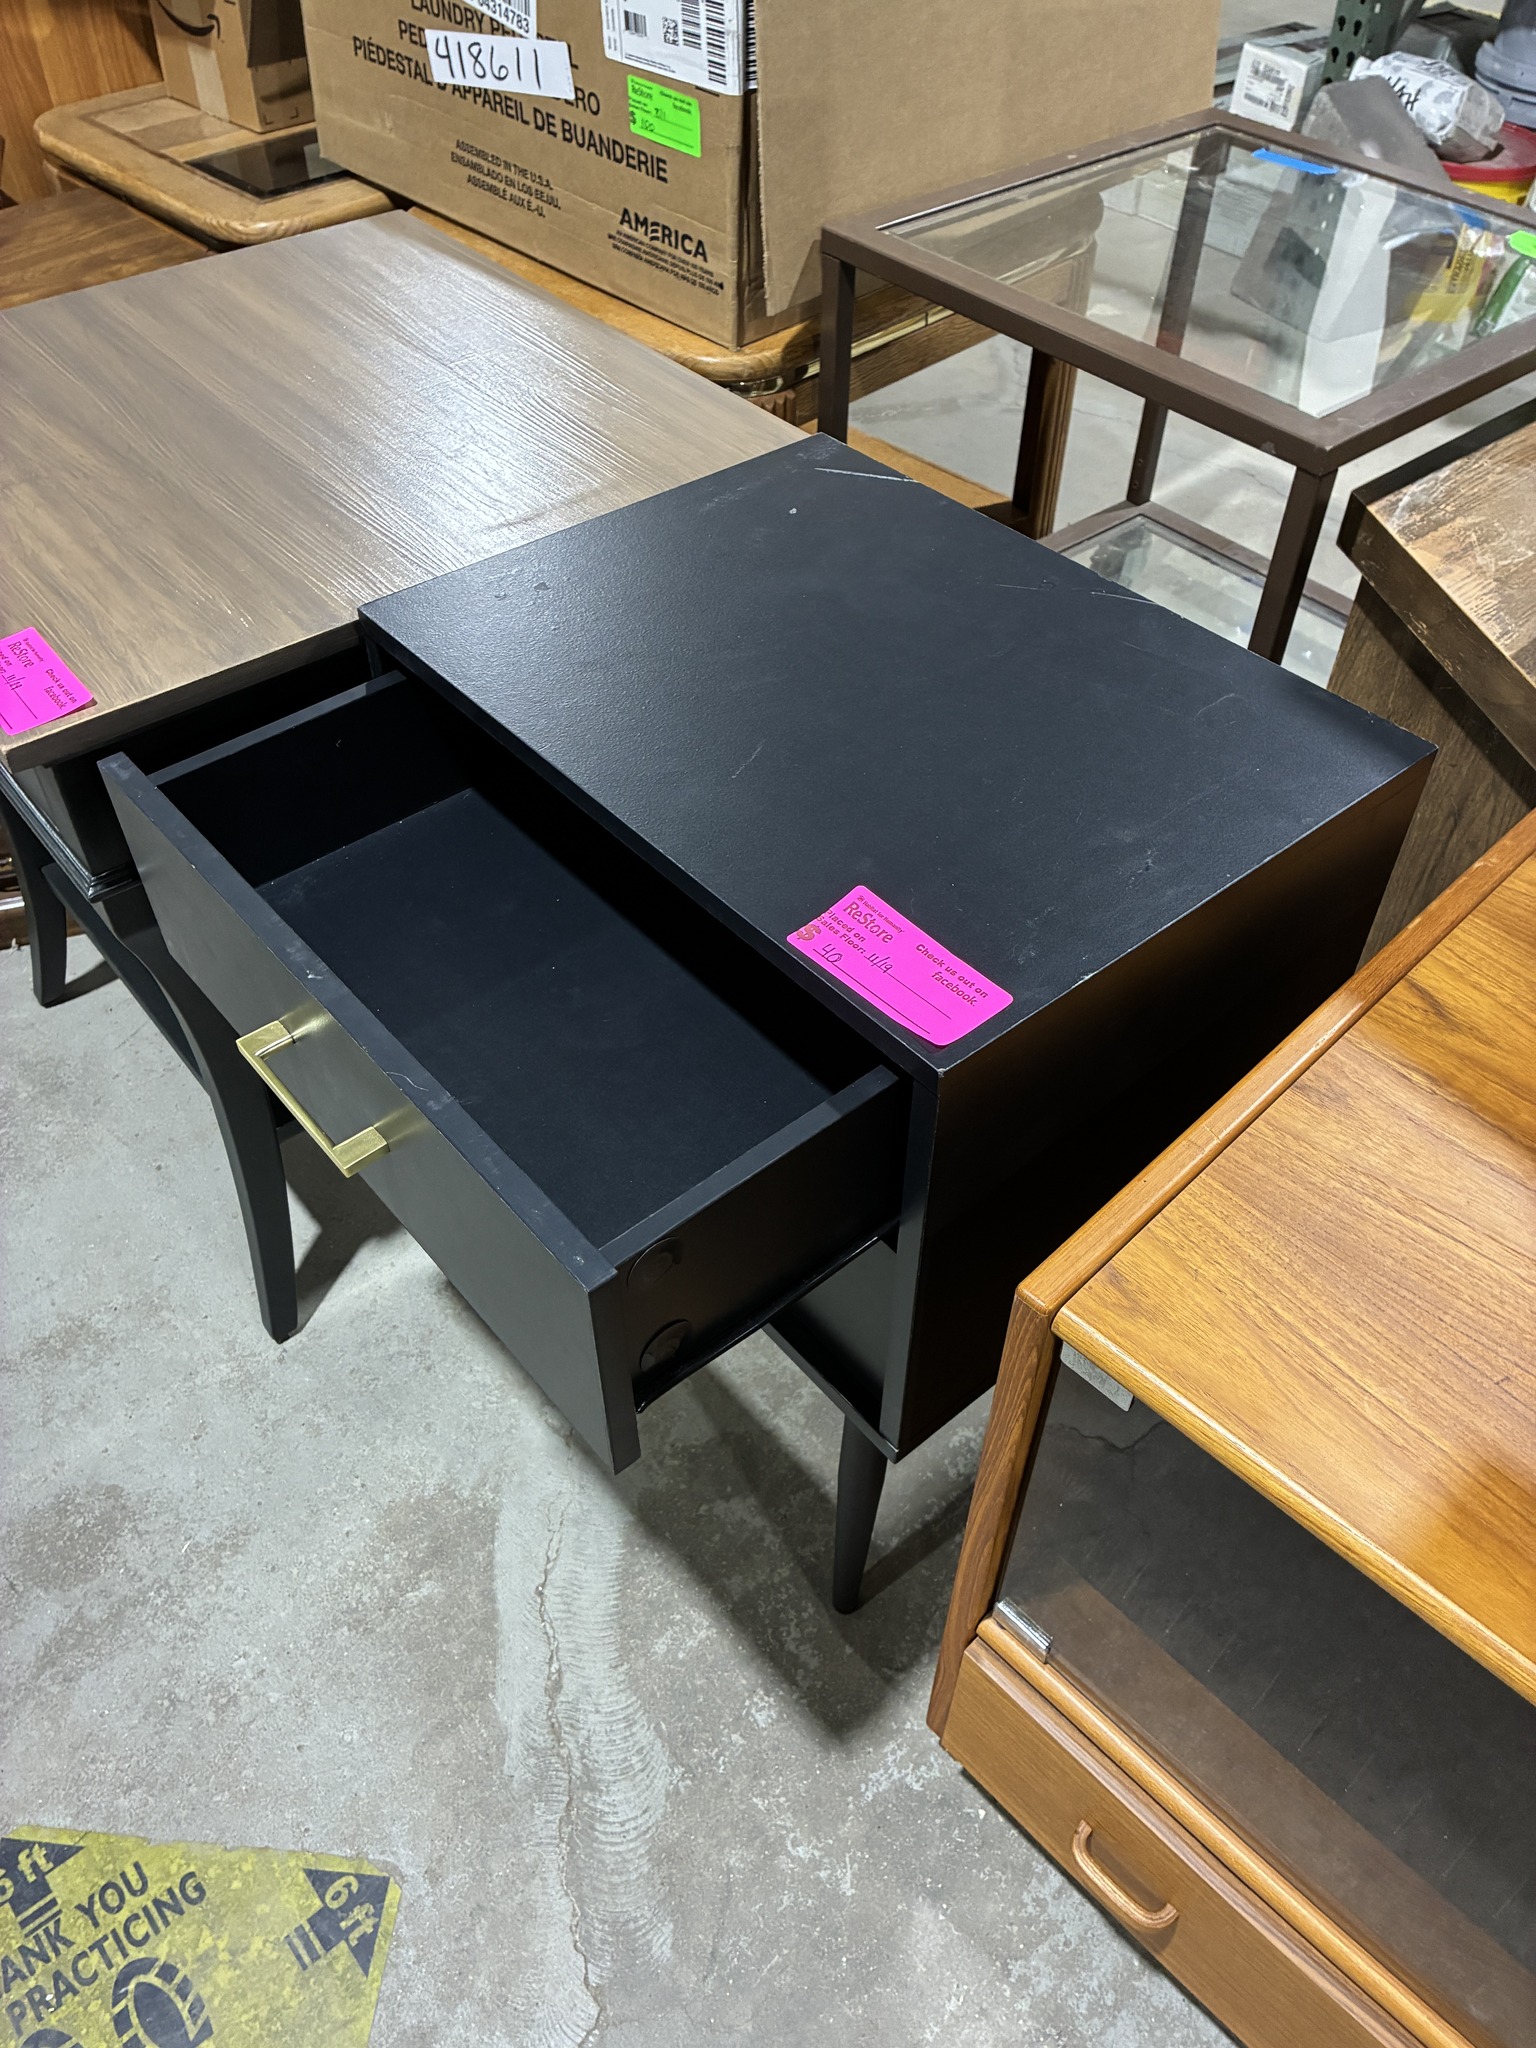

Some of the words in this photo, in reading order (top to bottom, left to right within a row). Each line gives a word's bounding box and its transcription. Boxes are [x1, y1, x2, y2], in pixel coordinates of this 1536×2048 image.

[435, 35, 542, 90] 418611
[352, 35, 433, 86] PIÉDESTAL
[437, 82, 530, 125] APPAREIL
[533, 106, 557, 138] DE
[562, 119, 668, 184] BUANDERIE
[456, 139, 501, 167] ASSEMBLED
[503, 160, 512, 172] IN
[513, 163, 528, 180] THE
[504, 175, 516, 189] EN
[619, 207, 708, 263] AMERICA
[8, 641, 34, 668] ReStore
[816, 915, 840, 935] Sales
[840, 933, 866, 954] Floor:
[826, 909, 855, 933] Placed
[853, 933, 866, 942] on
[843, 901, 894, 943] ReStore
[796, 924, 821, 941] $
[822, 943, 843, 963] 40
[916, 944, 945, 967] Check
[945, 966, 957, 976] us
[958, 975, 975, 988] out
[975, 987, 988, 998] on
[18, 1843, 54, 1883] ft
[324, 1875, 359, 1910] 6
[1, 1917, 75, 1994] ANK
[75, 1861, 148, 1929] YOU
[339, 1903, 380, 1947] ft
[5, 1871, 207, 2038] PRACTICING
